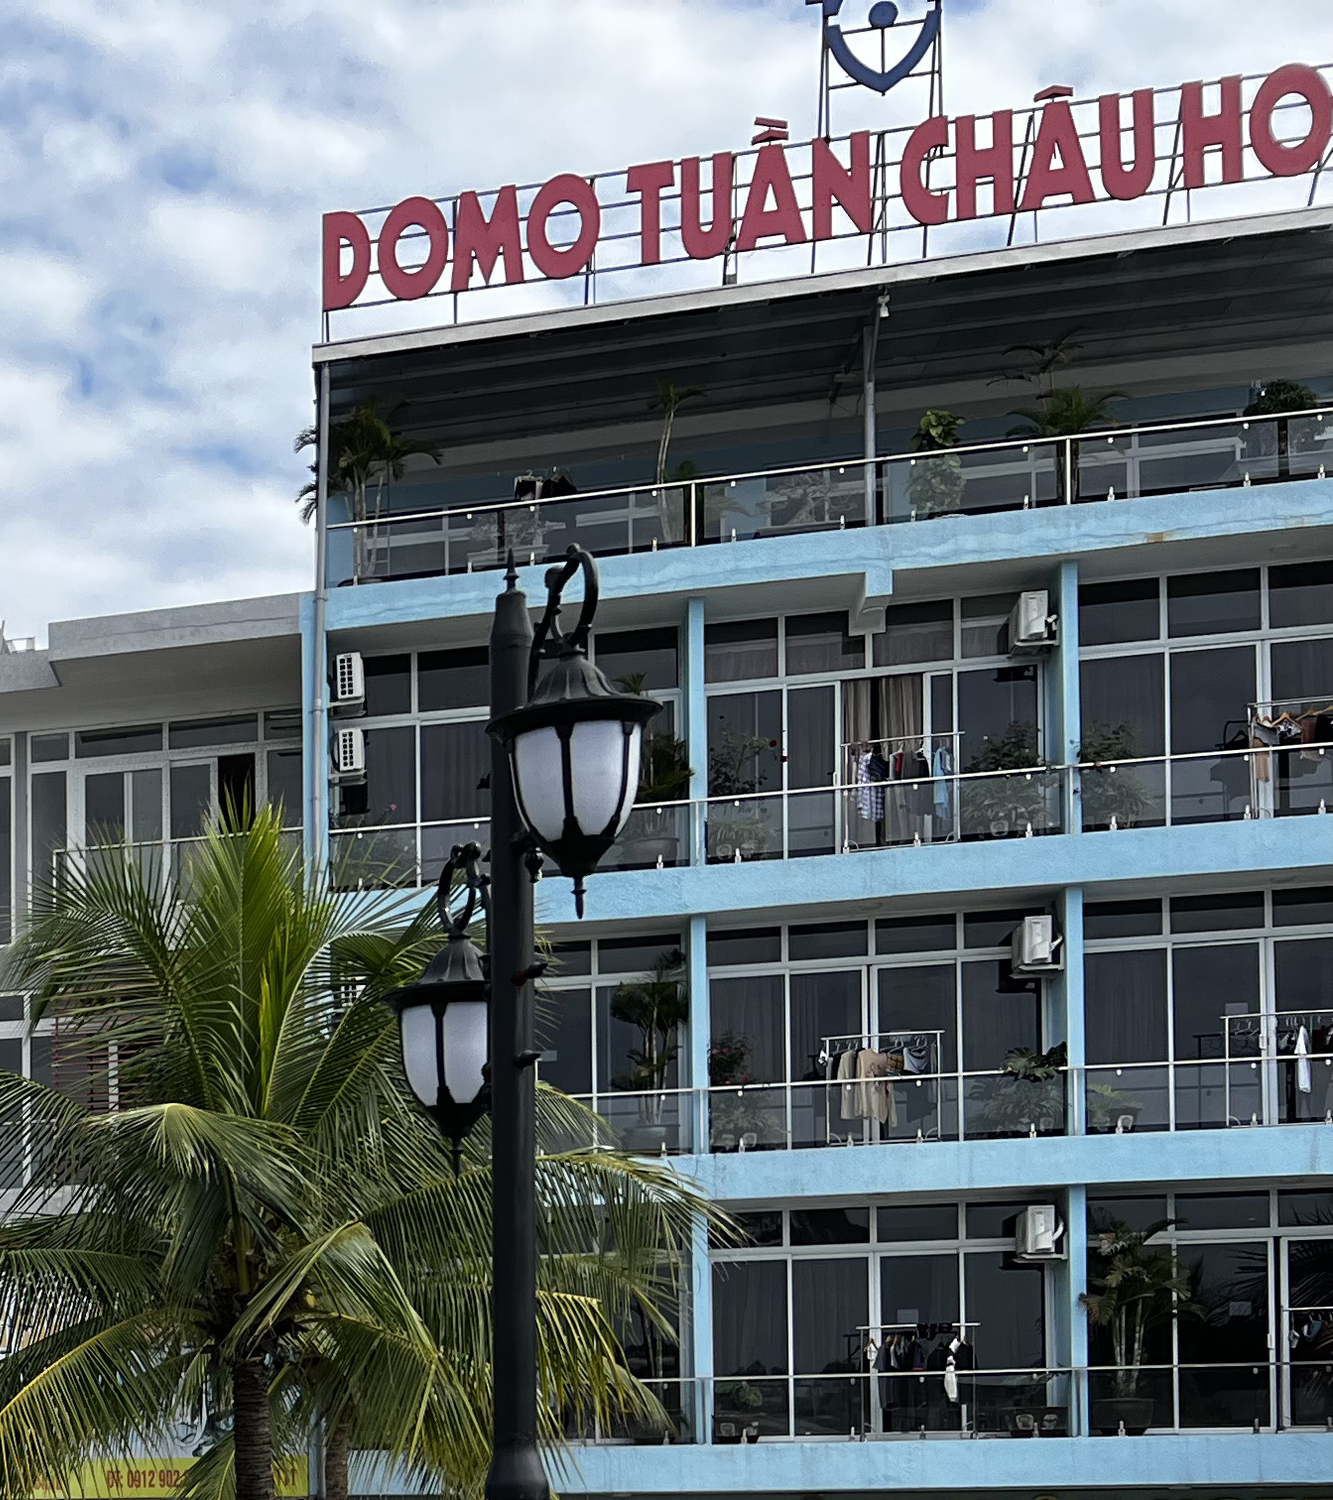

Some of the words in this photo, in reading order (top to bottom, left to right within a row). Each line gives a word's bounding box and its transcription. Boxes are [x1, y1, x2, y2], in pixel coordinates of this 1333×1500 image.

[322, 173, 601, 311] DOMO
[626, 117, 872, 265] TUẦN
[900, 84, 1156, 227] CHÂU
[1181, 62, 1333, 188] HO
[127, 1469, 155, 1489] 0912
